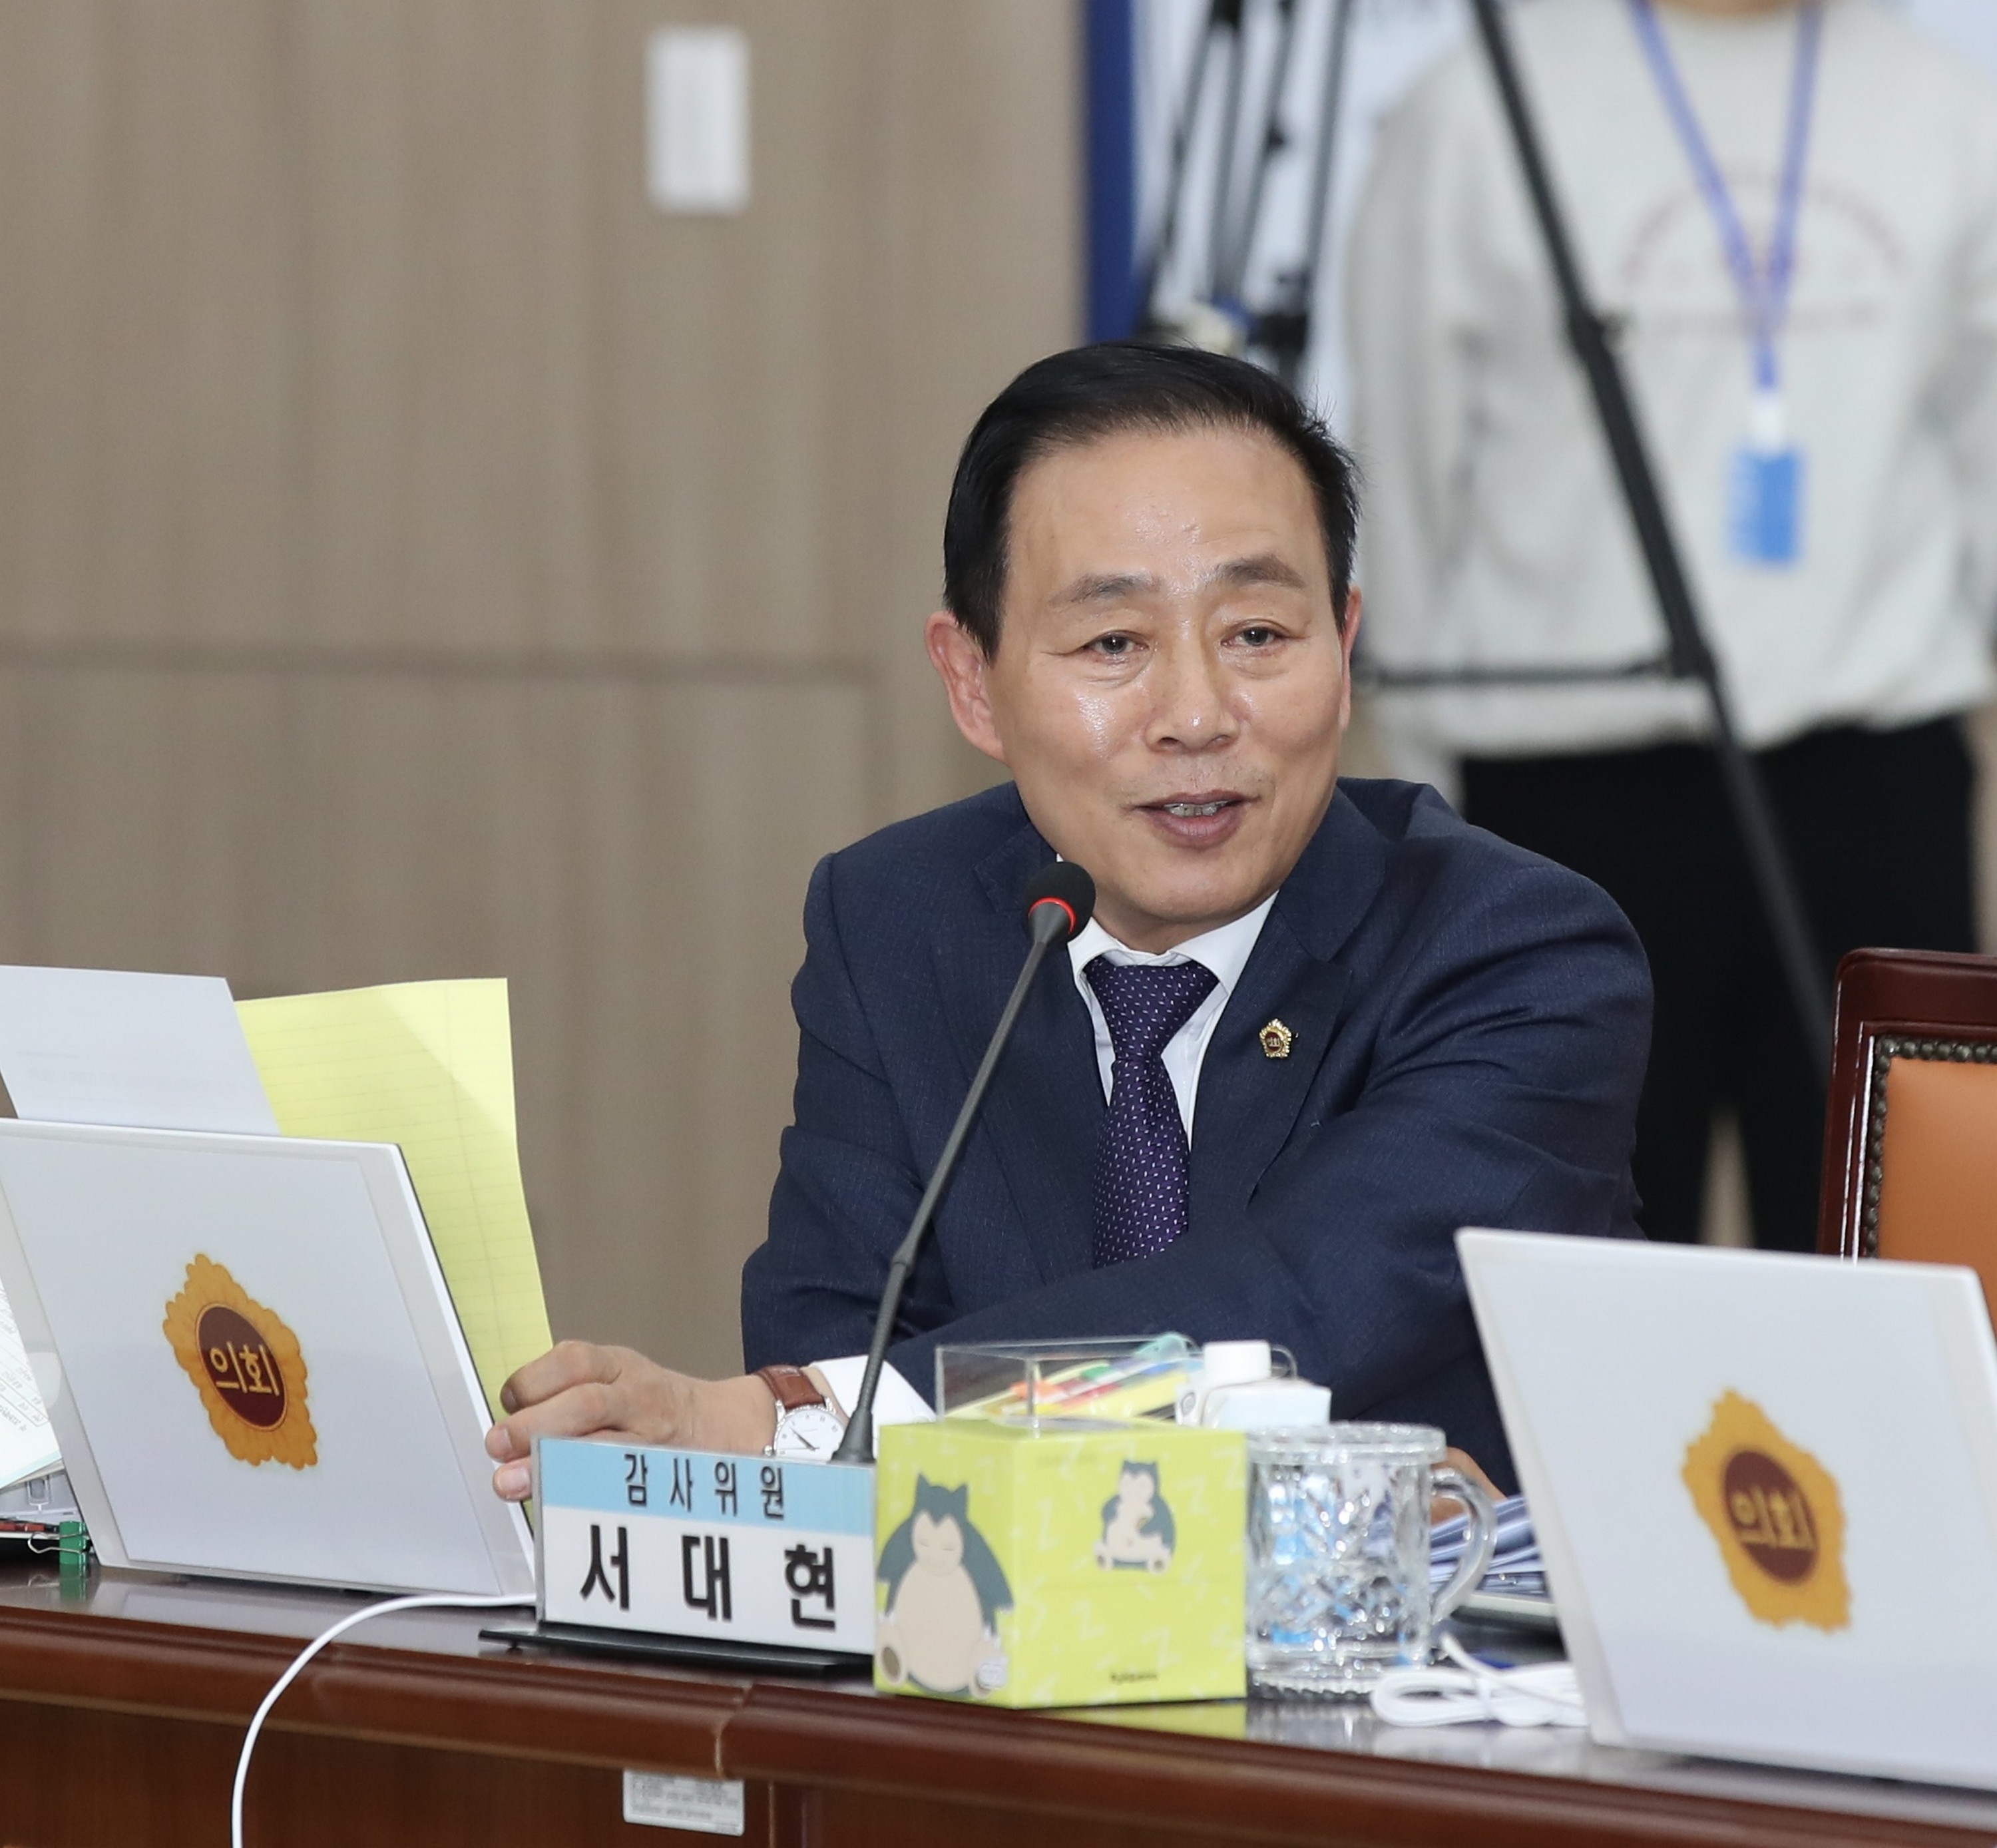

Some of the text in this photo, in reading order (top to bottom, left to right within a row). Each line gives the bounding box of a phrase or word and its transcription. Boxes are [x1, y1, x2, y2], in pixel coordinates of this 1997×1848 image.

[209, 1341, 280, 1396] 의회
[623, 1452, 785, 1520] 감사위원
[580, 1524, 836, 1630] 서대현
